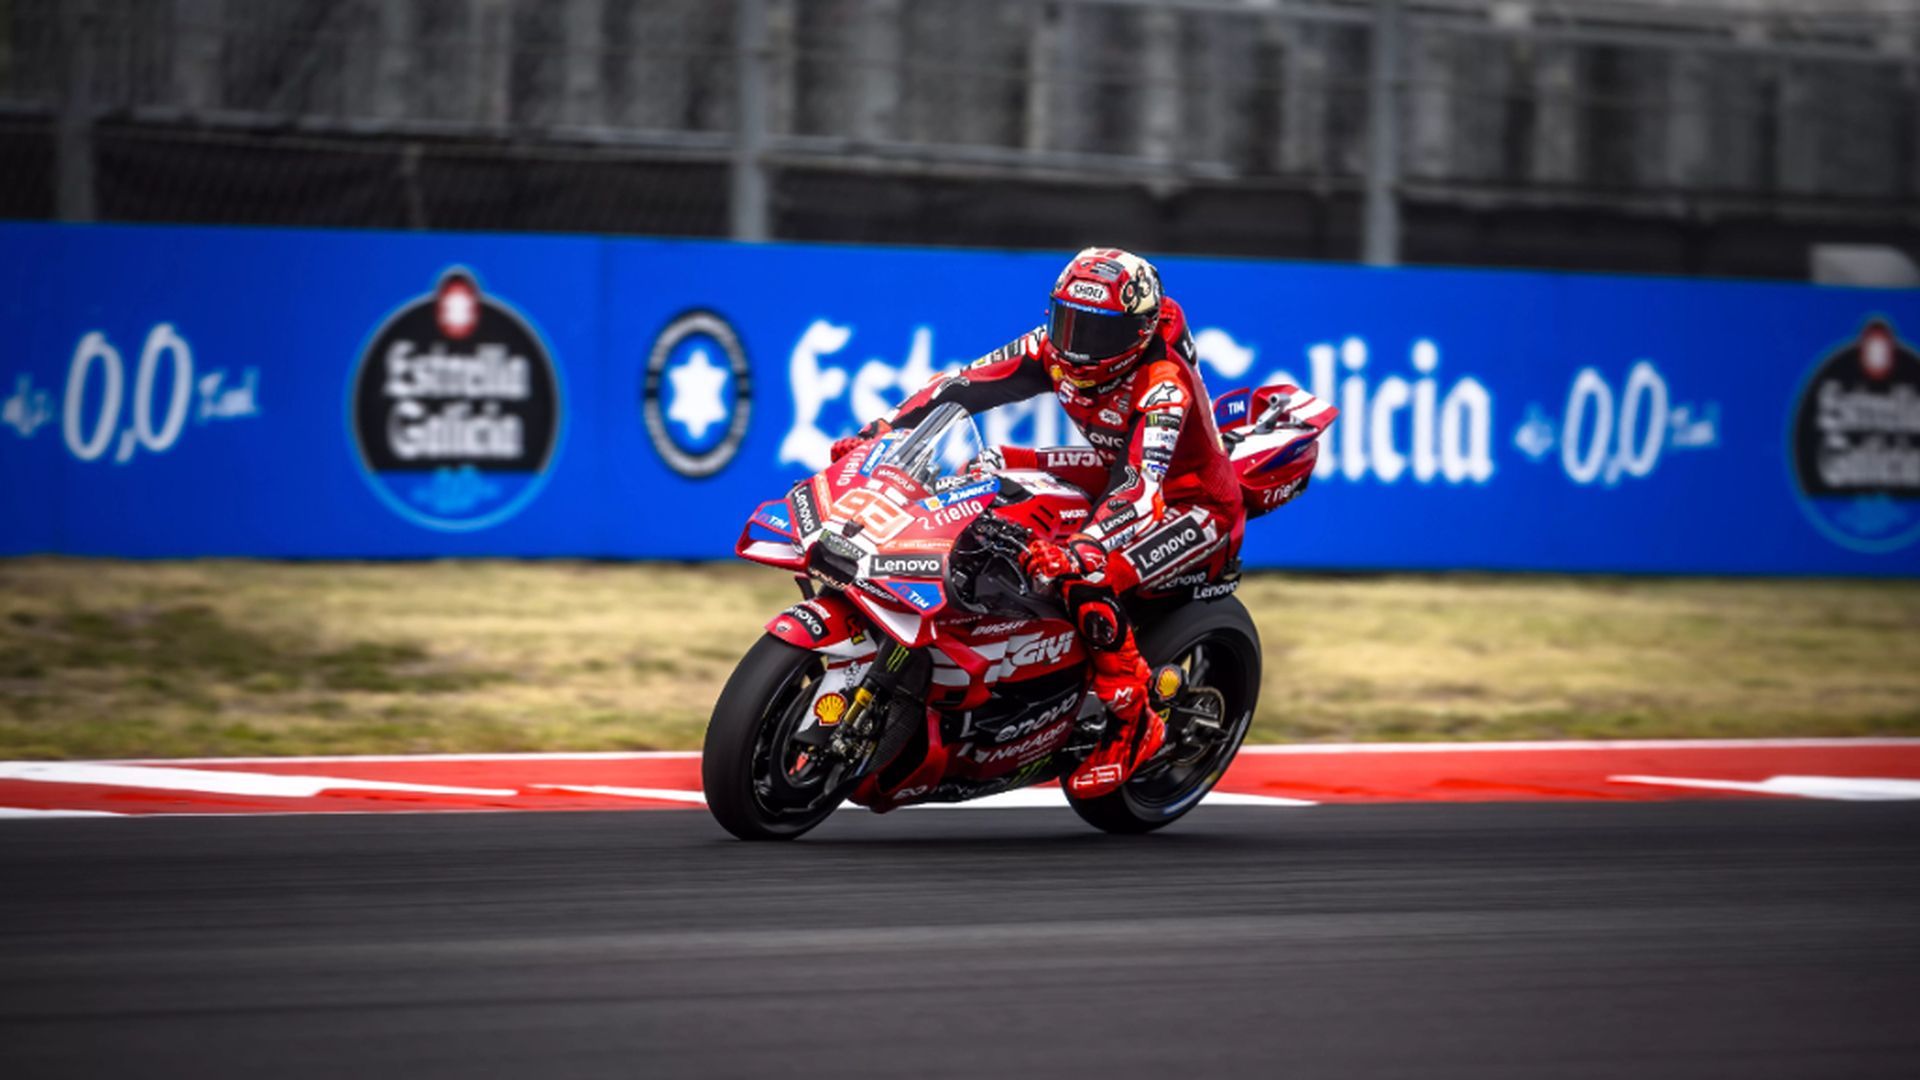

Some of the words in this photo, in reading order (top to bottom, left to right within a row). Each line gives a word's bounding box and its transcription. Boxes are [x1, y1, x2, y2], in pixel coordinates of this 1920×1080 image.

[64, 322, 192, 462] 0,0
[1228, 400, 1246, 416] TIM
[1562, 362, 1668, 484] 0,0
[794, 486, 815, 532] Lenovo
[934, 499, 984, 526] riello
[1101, 509, 1136, 532] Lenovo
[1138, 527, 1197, 570] Lenovo
[874, 558, 940, 572] Lenovo
[907, 590, 930, 609] TIM
[1193, 580, 1239, 600] Lenovo
[1012, 630, 1076, 666] GIVI
